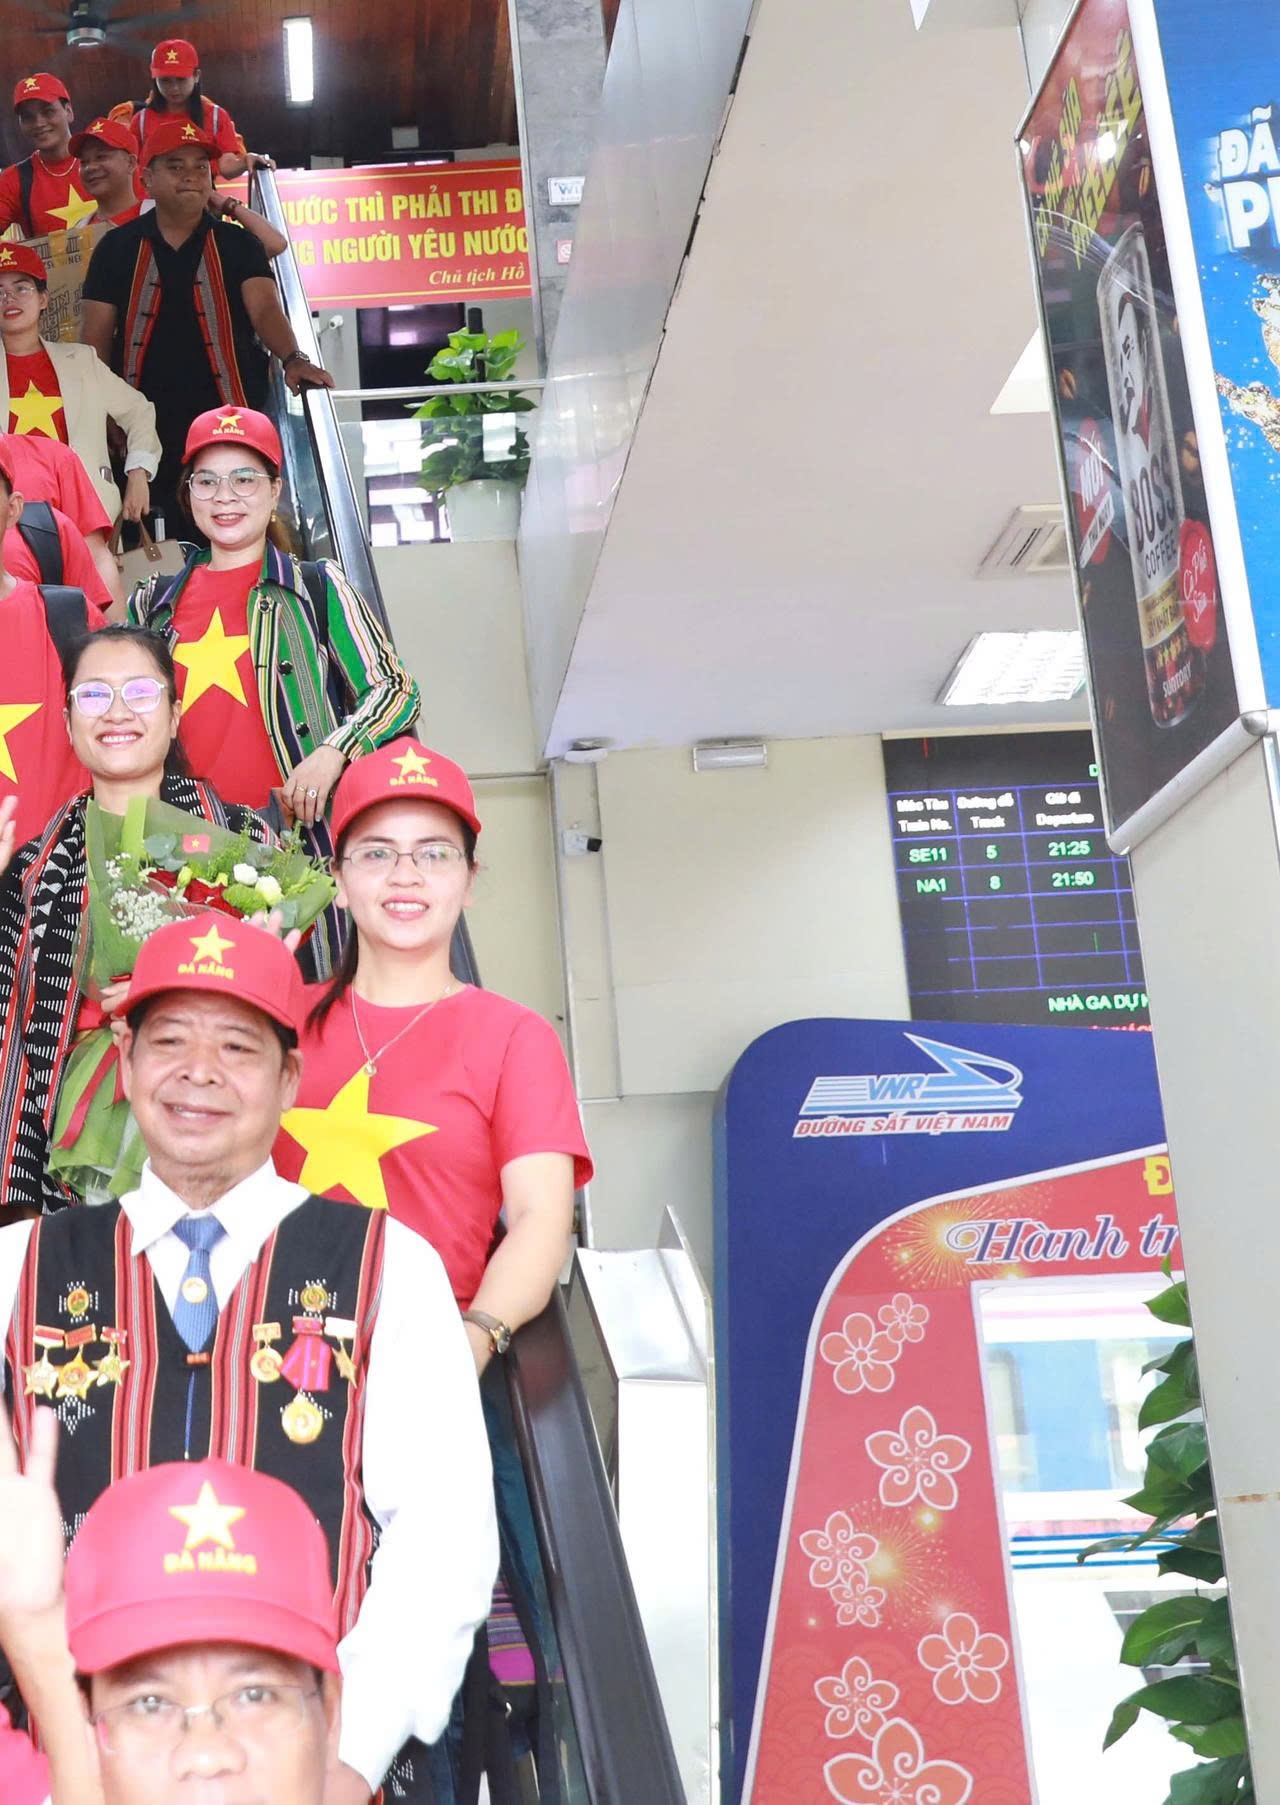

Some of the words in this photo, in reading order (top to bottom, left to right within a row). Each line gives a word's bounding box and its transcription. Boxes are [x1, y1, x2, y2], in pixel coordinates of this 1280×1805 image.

[345, 191, 385, 223] THÌ
[391, 184, 452, 220] PHẢI
[458, 189, 498, 216] THI
[1223, 176, 1280, 248] P
[323, 230, 401, 265] NGƯỜI
[407, 228, 456, 259] YÊU
[463, 223, 528, 256] NƯỚC
[467, 268, 496, 286] tịch
[501, 262, 525, 281] Hồ
[1130, 446, 1176, 553] BOSS
[1144, 530, 1177, 580] COFFEE
[909, 847, 947, 864] SE11
[986, 845, 998, 860] 5
[1048, 841, 1091, 857] 21:25
[916, 878, 946, 894] NA1
[1052, 871, 1094, 888] 21:50
[1048, 994, 1084, 1012] NHÀ
[1085, 995, 1112, 1011] GA
[870, 1075, 924, 1100] VNR
[796, 1116, 865, 1136] ĐƯỜNG
[871, 1112, 909, 1132] SẮT
[915, 1113, 958, 1135] VIỆT
[961, 1115, 1010, 1130] NAM
[944, 1214, 1129, 1265] Hành
